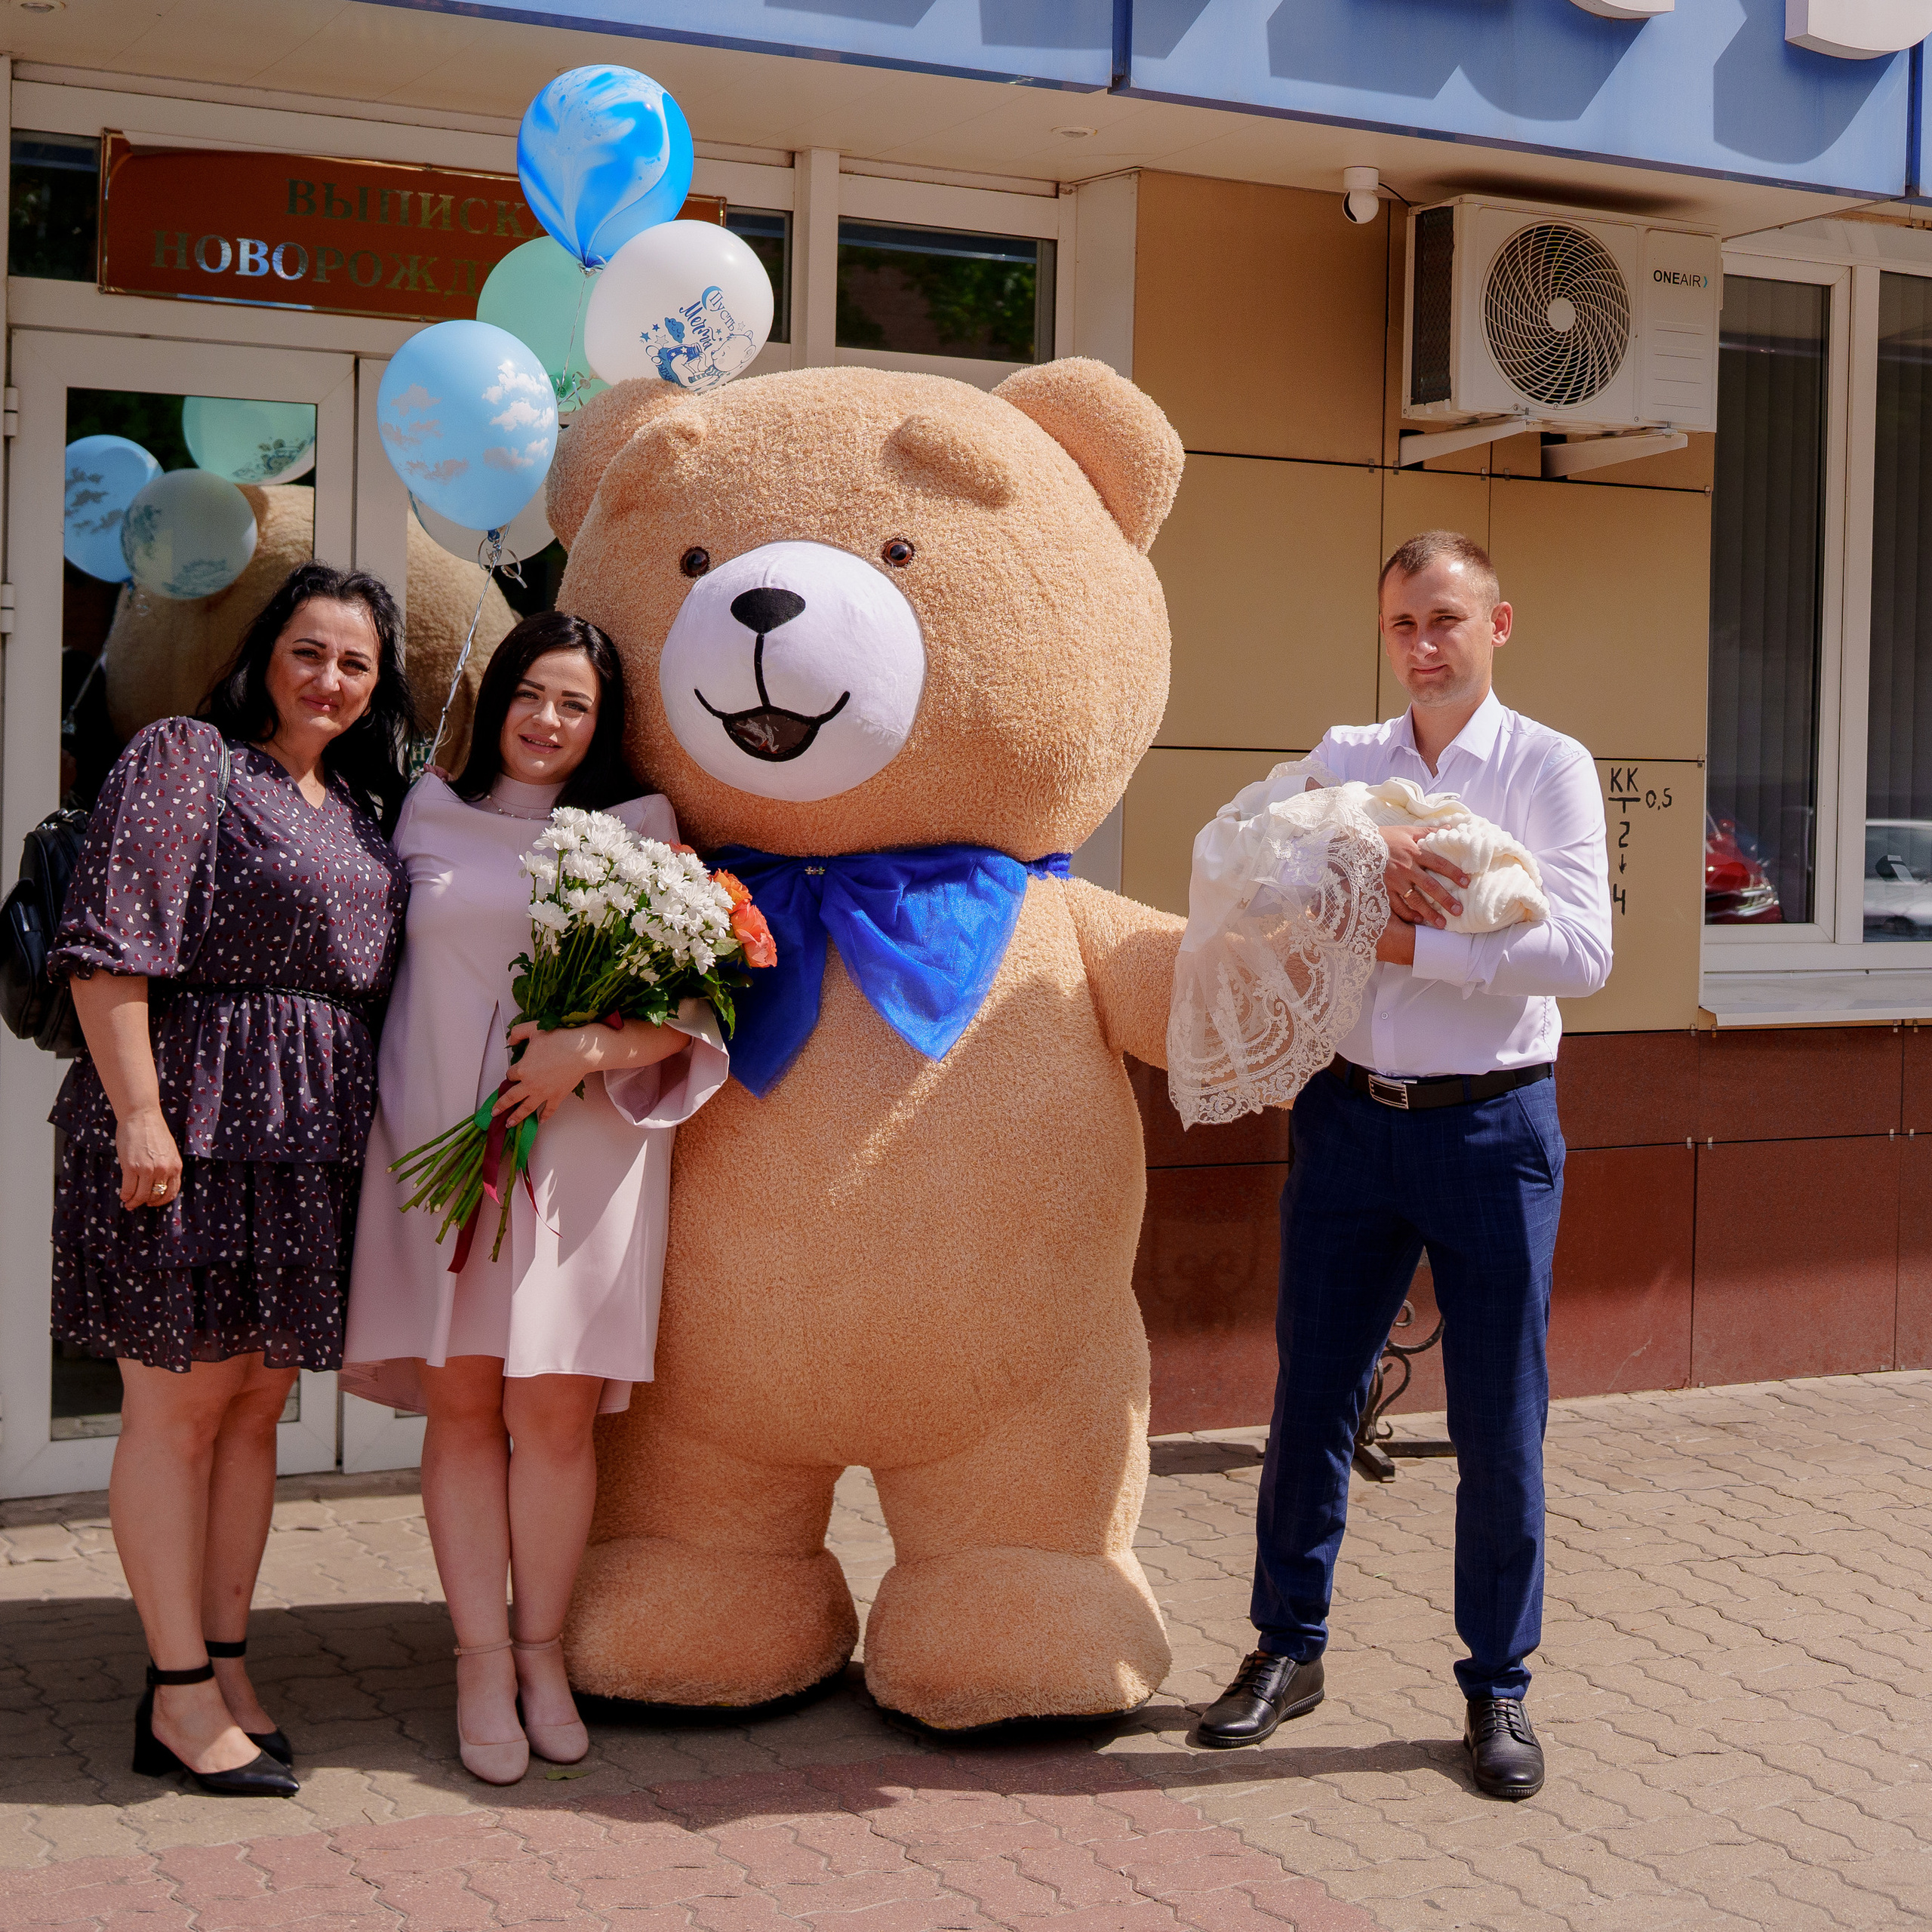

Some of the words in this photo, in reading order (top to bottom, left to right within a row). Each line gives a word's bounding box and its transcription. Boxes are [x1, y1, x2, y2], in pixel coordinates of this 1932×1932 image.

[152, 229, 497, 301] НОВОРОЖД
[1653, 269, 1701, 288] ONEAIR
[678, 300, 716, 352] Мечты
[709, 291, 736, 332] Пусть
[1618, 821, 1631, 848] 2
